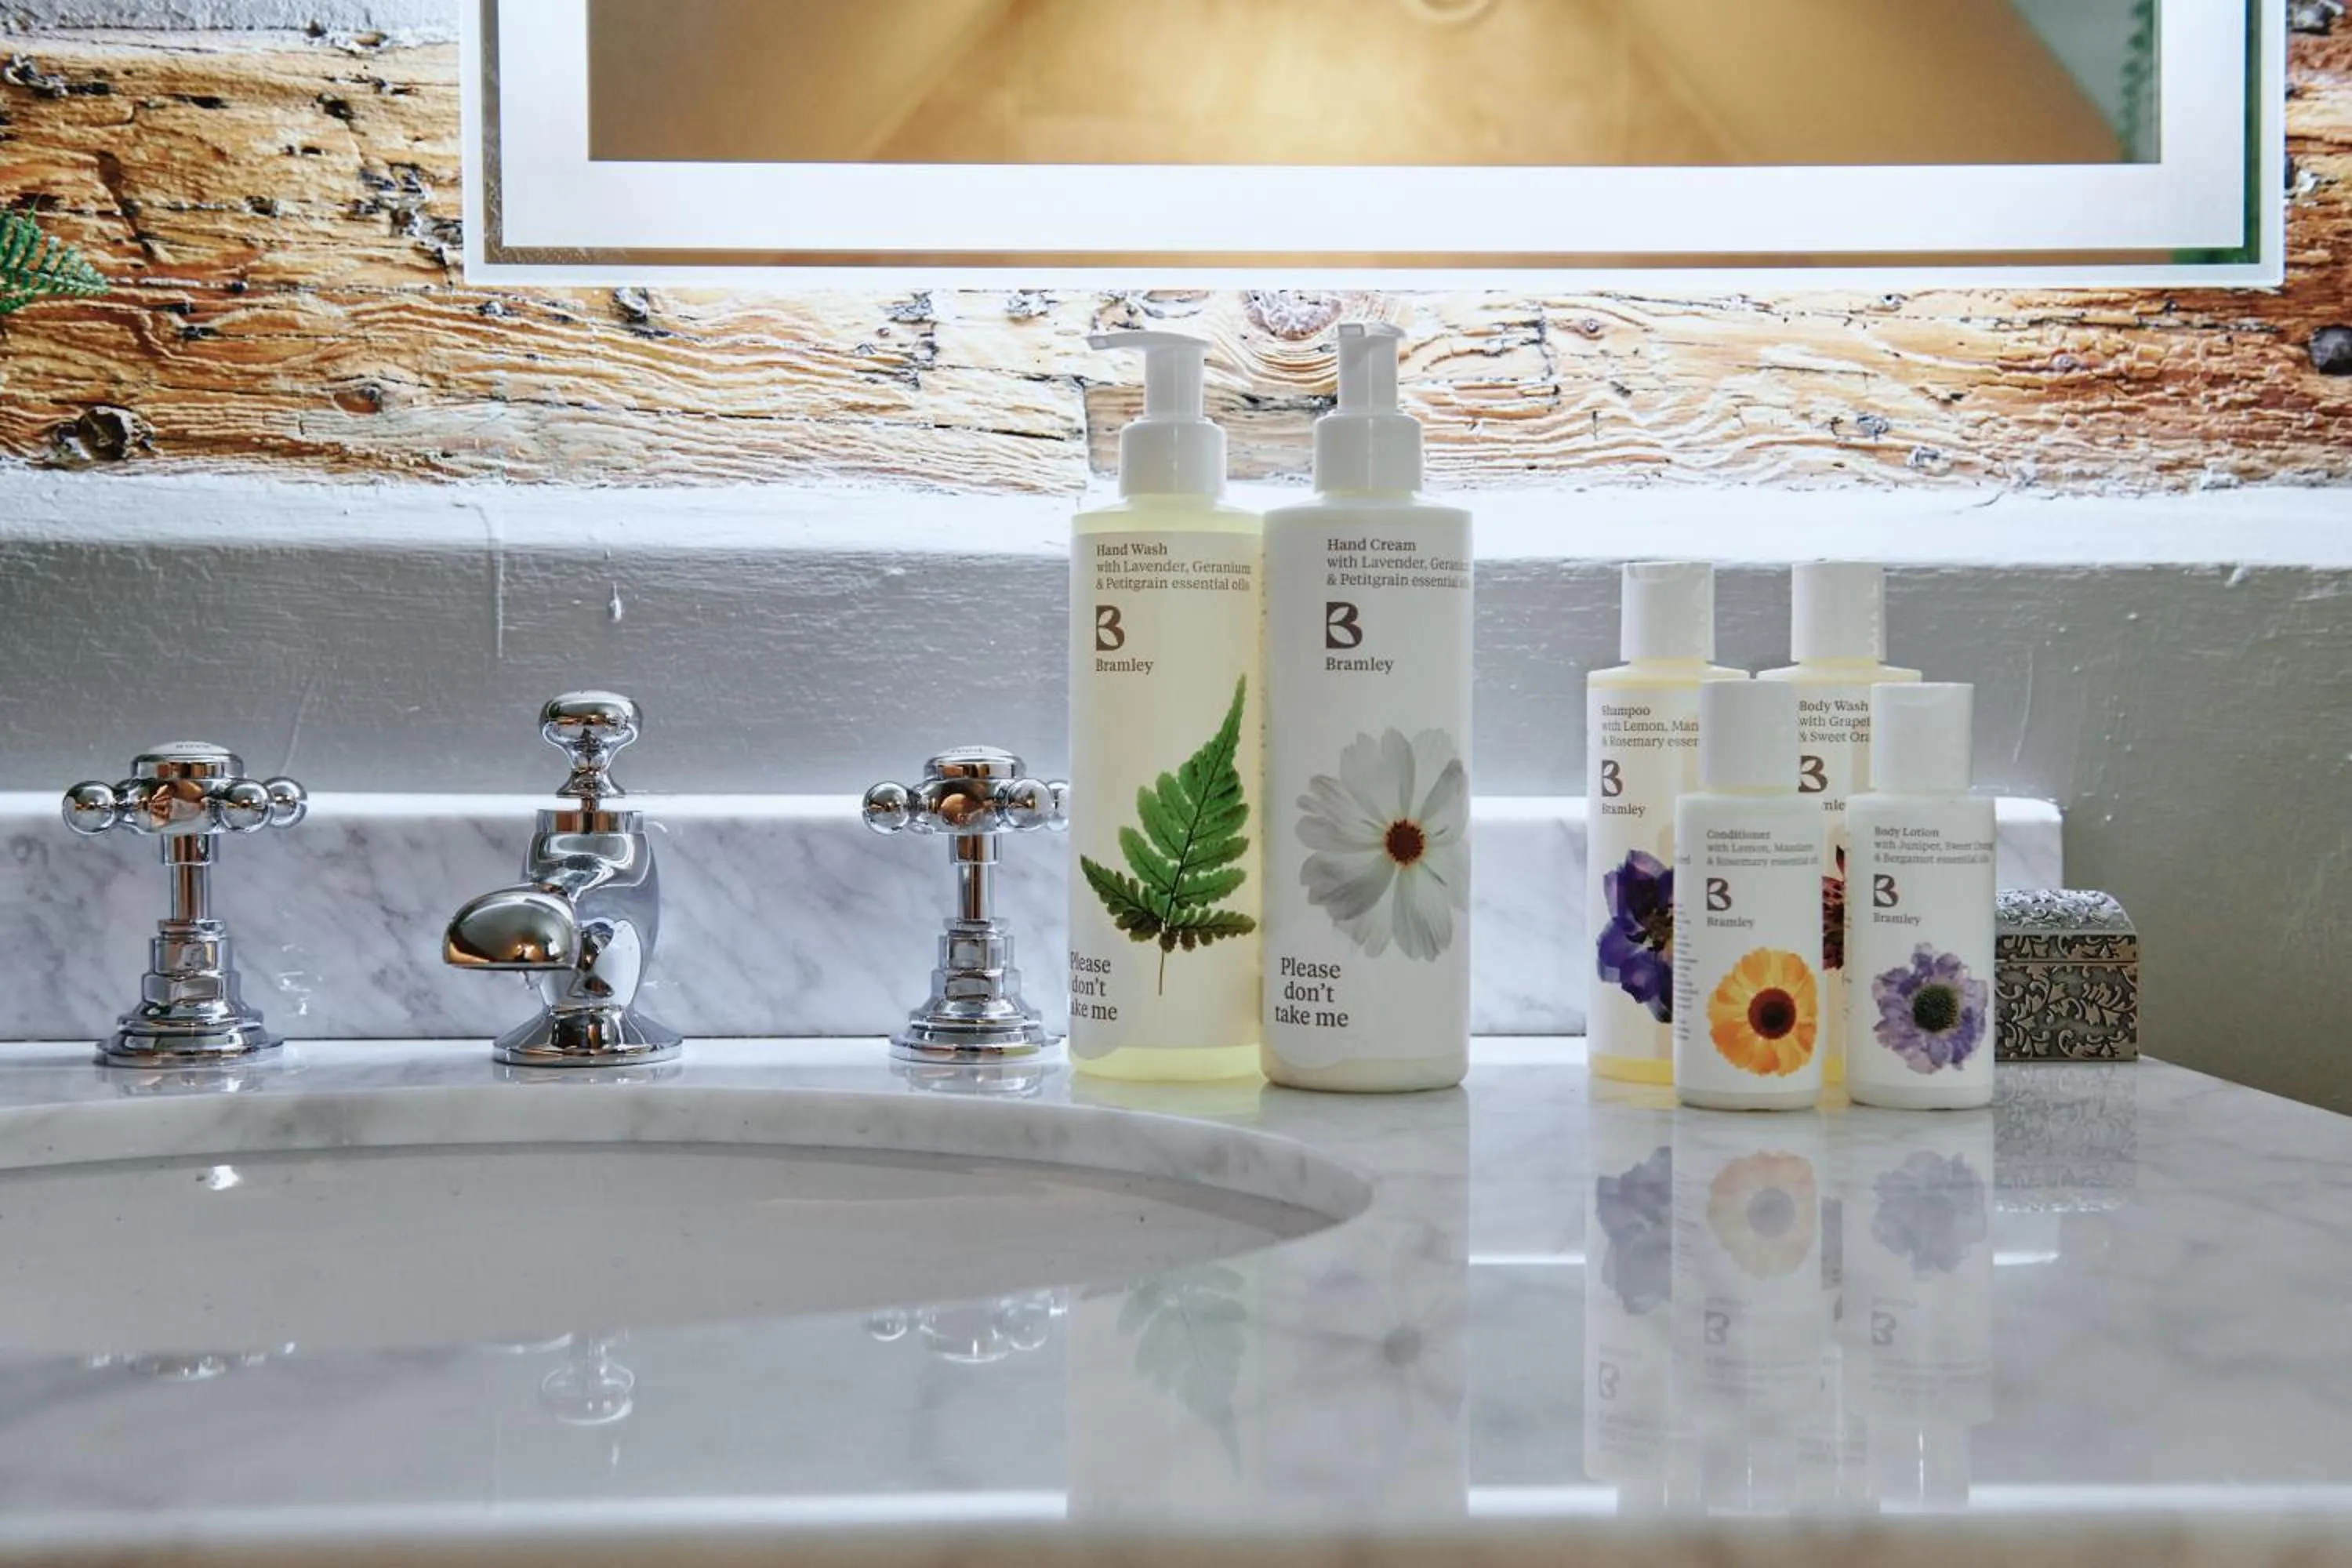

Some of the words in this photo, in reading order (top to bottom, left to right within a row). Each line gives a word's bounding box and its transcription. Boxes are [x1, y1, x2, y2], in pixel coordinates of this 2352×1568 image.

[1096, 543, 1128, 557] Hand
[1130, 542, 1168, 556] Wash
[1327, 538, 1367, 551] Hand
[1370, 538, 1417, 551] Cream
[1096, 559, 1120, 573] with
[1123, 559, 1189, 574] Lavender,
[1192, 561, 1251, 575] Geranium
[1327, 555, 1357, 568] with
[1362, 555, 1428, 571] Lavender,
[1095, 577, 1103, 590] &
[1106, 576, 1168, 592] Petitgrain
[1171, 577, 1229, 590] essential
[1327, 574, 1336, 586] &
[1341, 573, 1409, 588] Petitgrain
[1095, 604, 1125, 652] B
[1326, 601, 1363, 649] B
[1095, 657, 1154, 675] Bramley
[1326, 656, 1394, 673] Bramley
[1602, 704, 1651, 718] Shampoo
[1798, 699, 1831, 713] Body
[1835, 699, 1869, 712] Wash
[1671, 720, 1700, 732] Man
[1799, 715, 1826, 727] with
[1610, 735, 1664, 750] Rosemary
[1809, 730, 1846, 743] Sweet
[1601, 759, 1624, 797] B
[1601, 802, 1646, 818] Bramley
[1706, 829, 1771, 840] Conditioner
[1875, 826, 1900, 838] Body
[1902, 826, 1940, 837] Lotion
[1706, 843, 1729, 853] with
[1874, 840, 1896, 850] with
[1706, 877, 1732, 912] B
[1872, 873, 1899, 908] B
[1706, 915, 1755, 930] Bramley
[1872, 912, 1922, 927] Bramley
[1070, 951, 1111, 974] Please
[1280, 956, 1341, 979] Please
[1091, 1004, 1117, 1022] me
[1275, 1004, 1310, 1025] take
[1315, 1011, 1349, 1028] me
